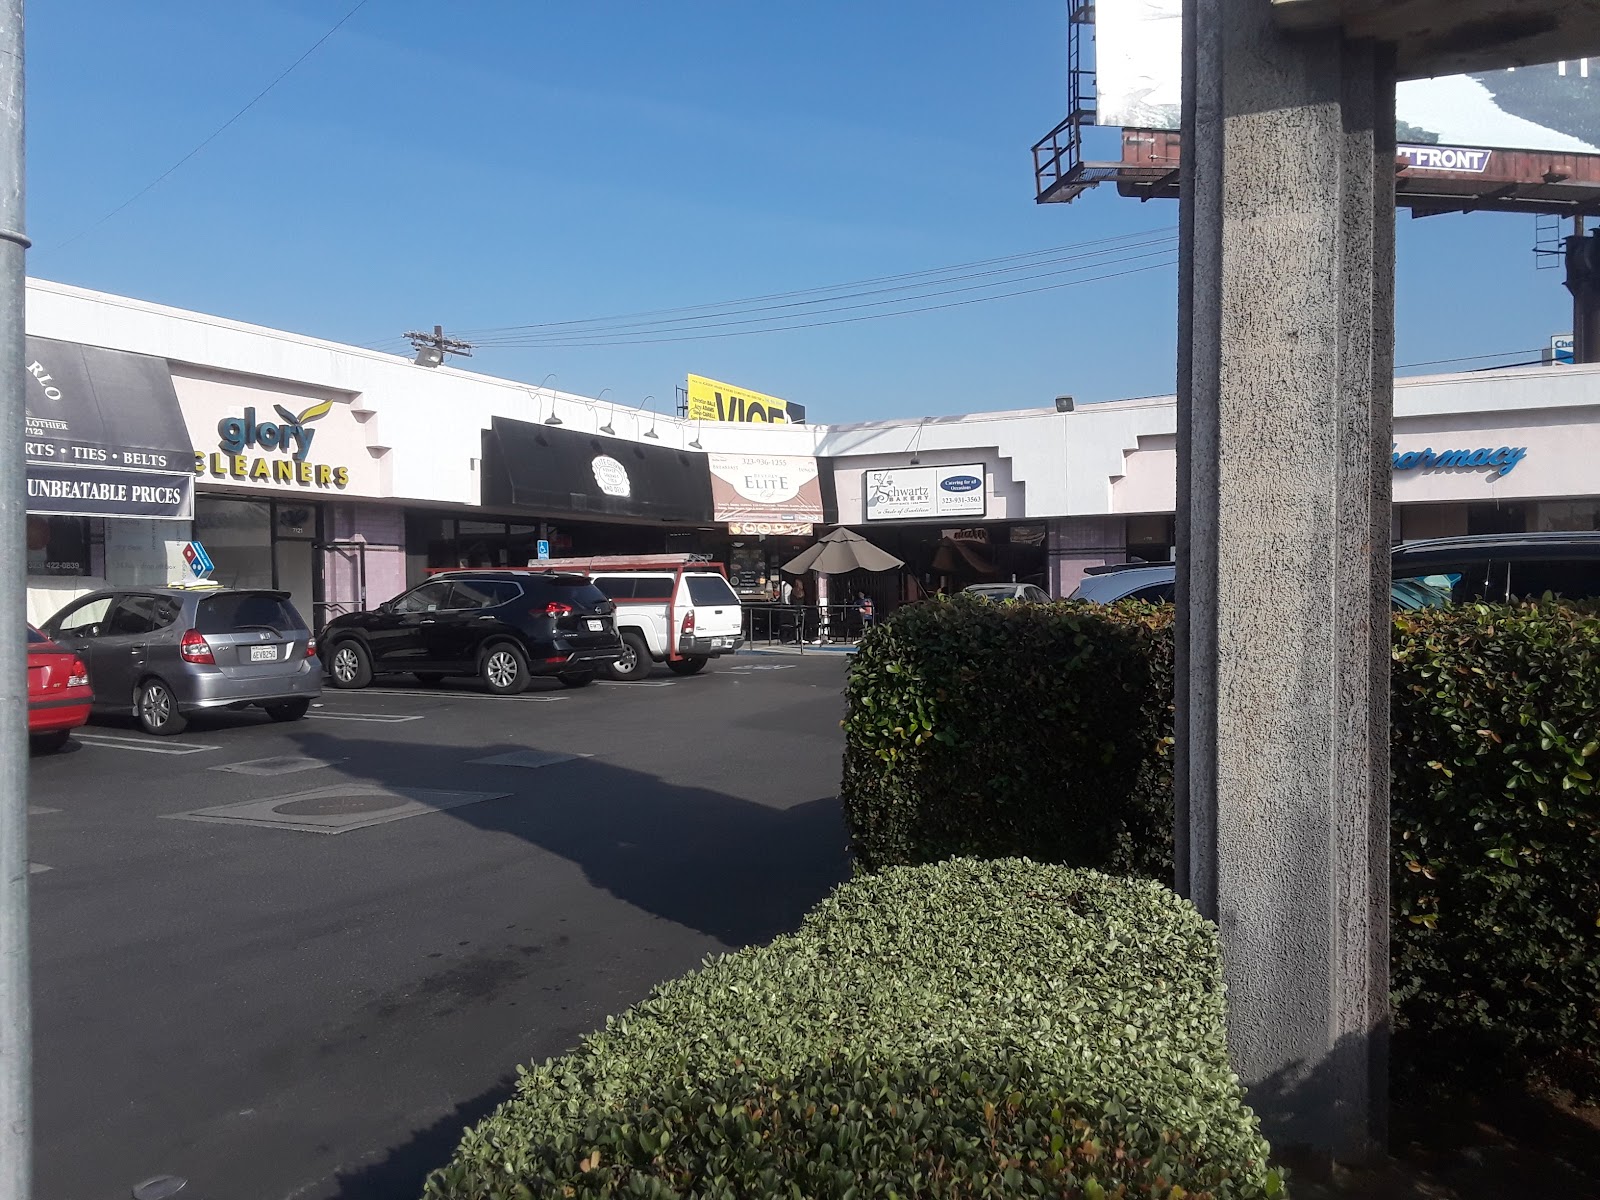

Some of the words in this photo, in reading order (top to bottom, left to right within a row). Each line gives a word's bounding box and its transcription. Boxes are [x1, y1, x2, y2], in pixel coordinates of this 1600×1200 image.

[219, 407, 315, 461] glory
[72, 446, 107, 461] TIES
[123, 452, 167, 467] BELTS
[742, 458, 787, 467] 323-936-1255
[744, 475, 789, 490] ELITE
[27, 479, 127, 501] UNBEATABLE
[131, 485, 181, 504] PRICES
[876, 486, 929, 503] Schwartz
[941, 495, 981, 504] 323-931-3563
